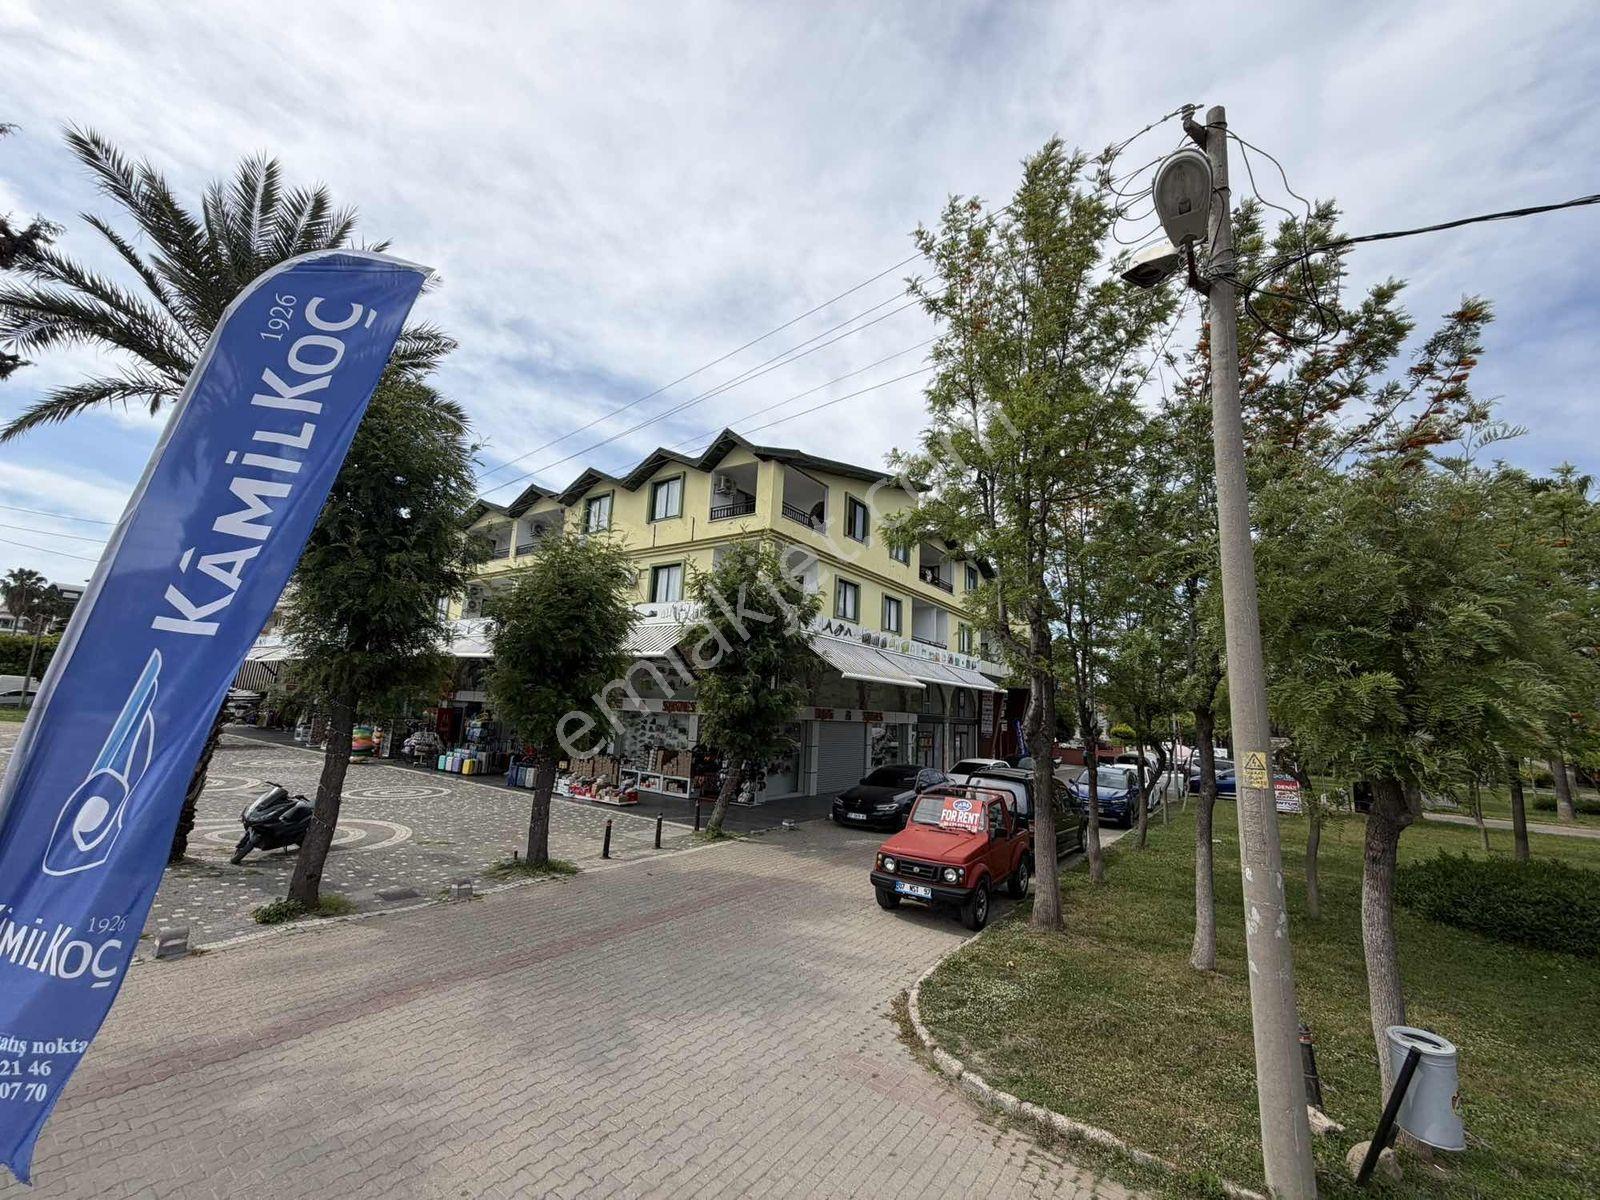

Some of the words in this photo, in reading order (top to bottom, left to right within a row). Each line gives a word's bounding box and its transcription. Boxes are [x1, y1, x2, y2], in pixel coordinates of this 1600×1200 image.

[260, 292, 297, 341] 1926
[940, 808, 957, 822] FOR
[957, 811, 980, 825] RENT
[88, 914, 129, 935] 1926
[0, 1034, 27, 1058] atış
[0, 1059, 22, 1076] 21
[27, 1060, 53, 1077] 46
[0, 1081, 22, 1100] 07
[24, 1082, 48, 1102] 70
